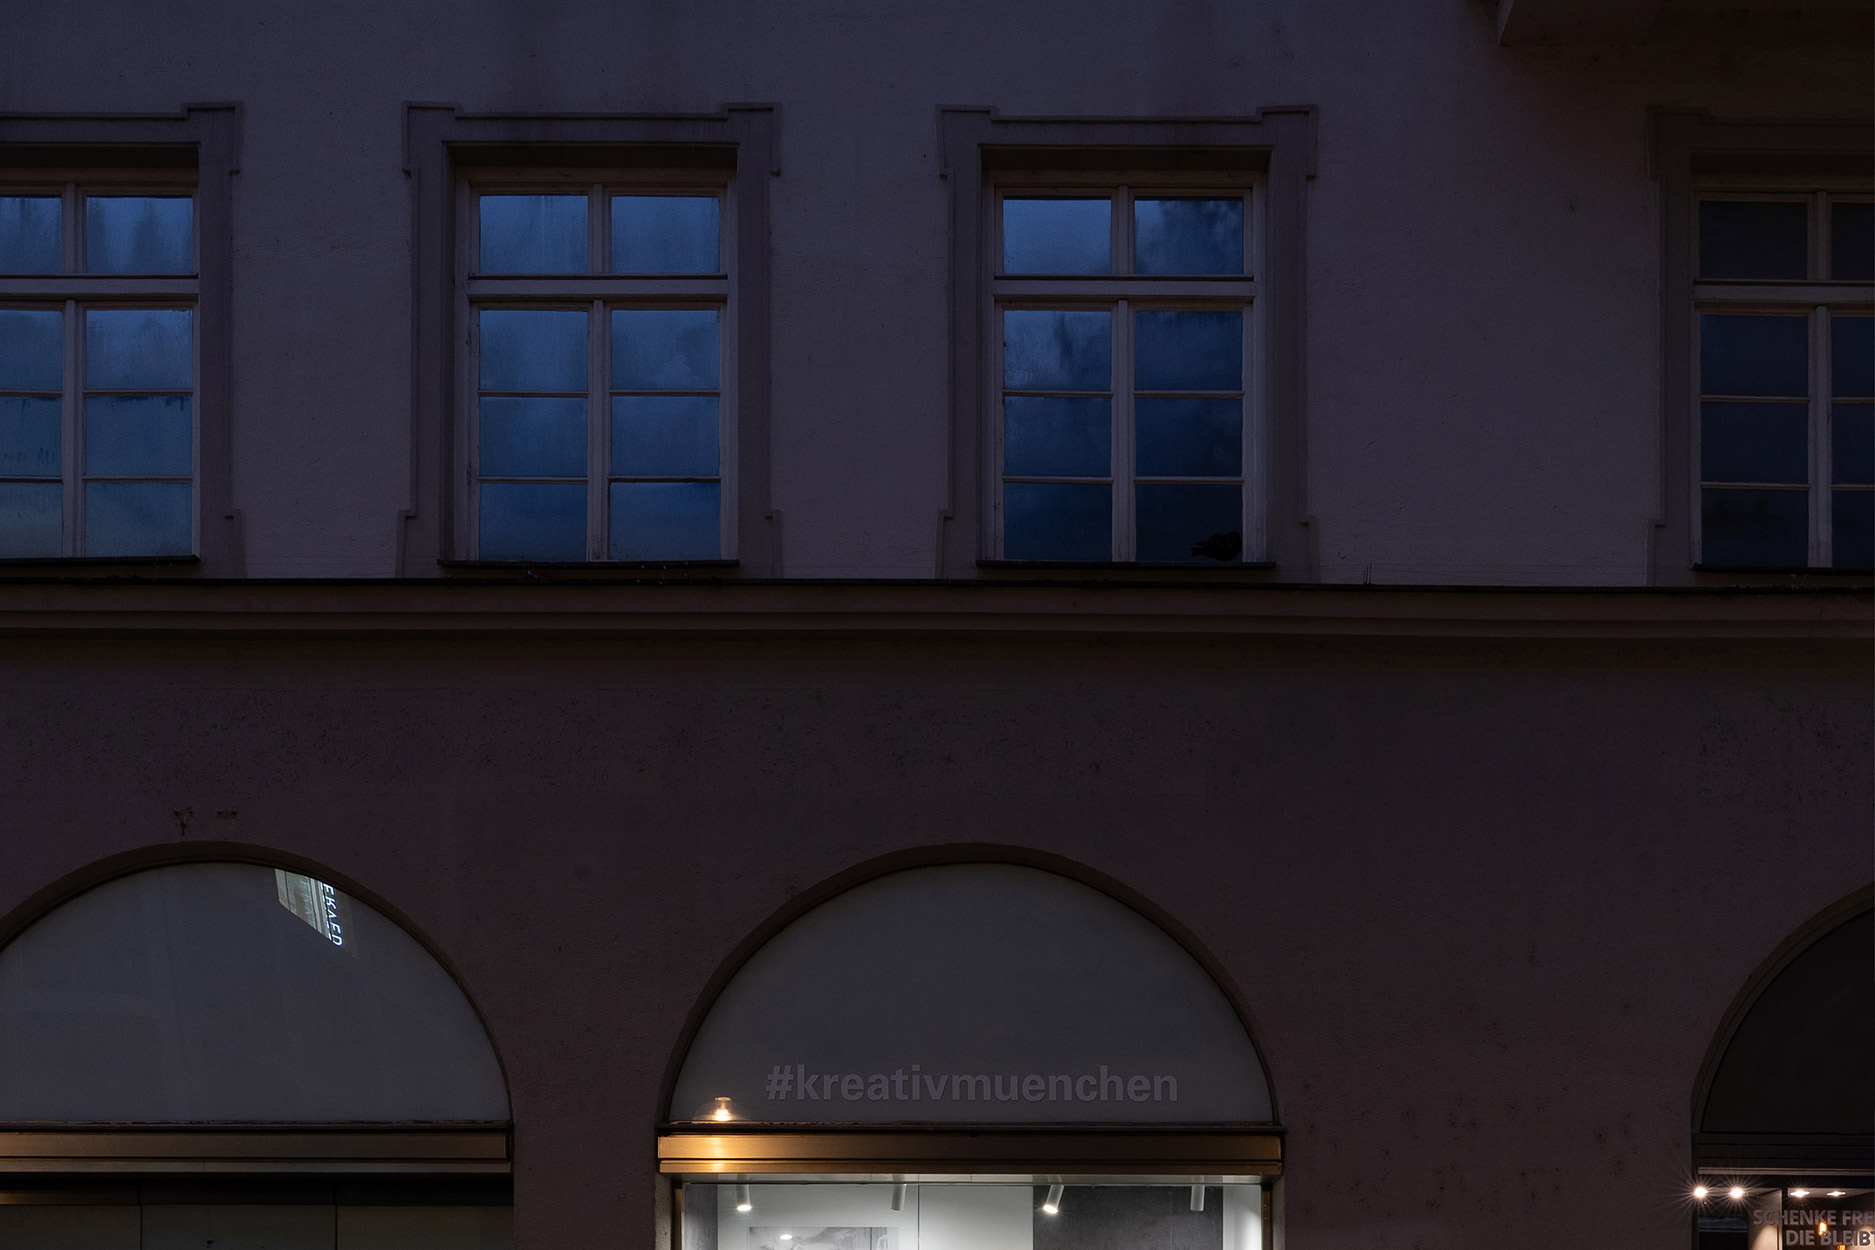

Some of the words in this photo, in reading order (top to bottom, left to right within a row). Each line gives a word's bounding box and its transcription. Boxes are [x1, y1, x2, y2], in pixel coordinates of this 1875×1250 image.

[765, 1064, 1179, 1103] #kreativmuenchen
[1753, 1209, 1837, 1226] SCHENKE
[1785, 1230, 1815, 1246] DIE
